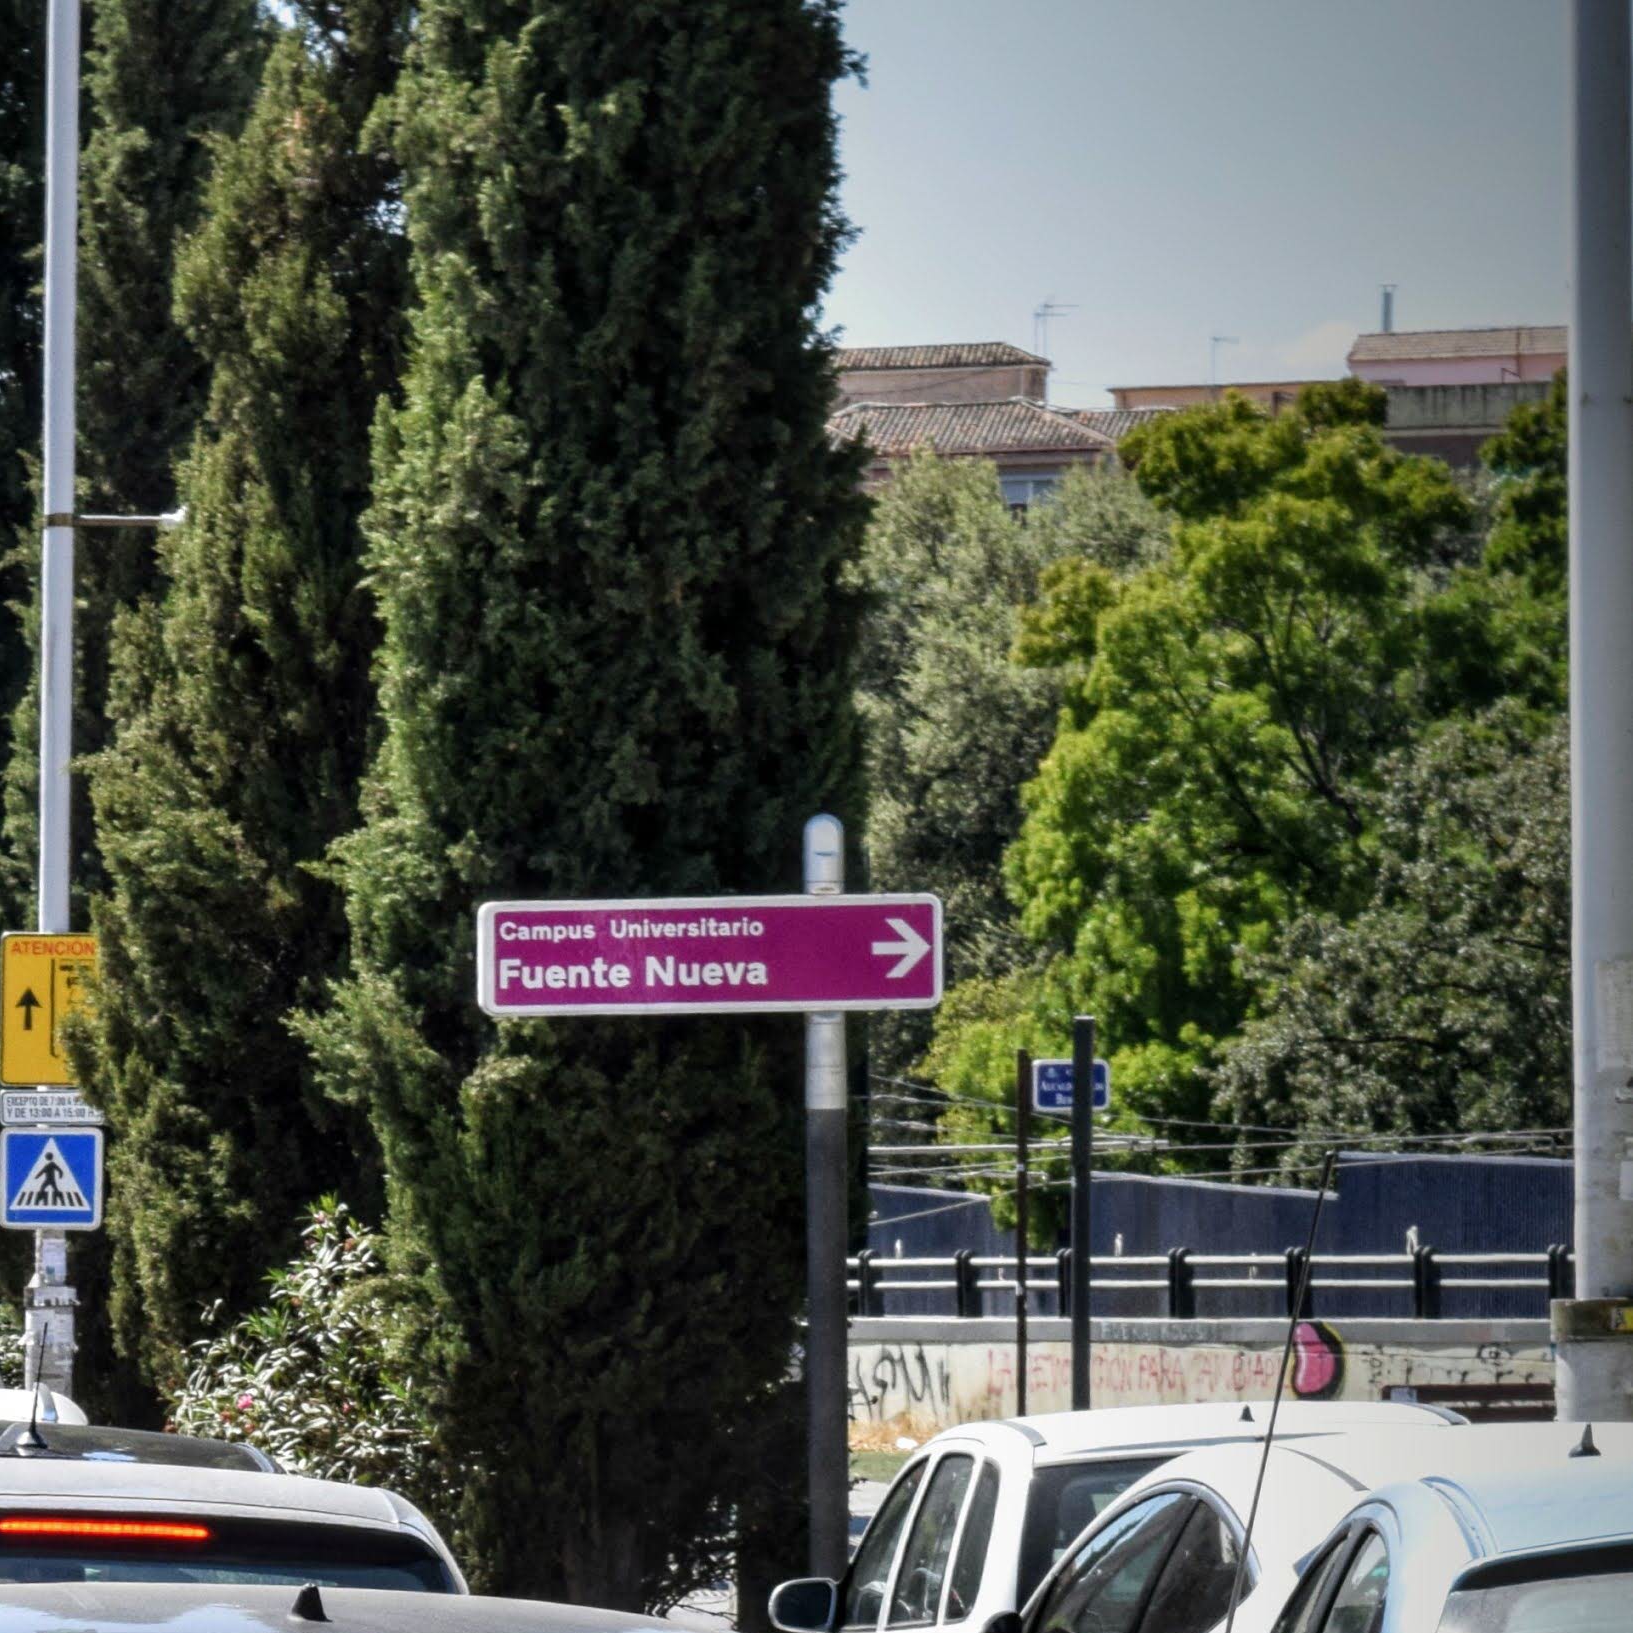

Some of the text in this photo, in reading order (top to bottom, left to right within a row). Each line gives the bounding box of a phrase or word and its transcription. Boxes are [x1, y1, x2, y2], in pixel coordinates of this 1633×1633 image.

[499, 918, 765, 943] Campus Universitario
[498, 955, 769, 990] Fuente Nueva
